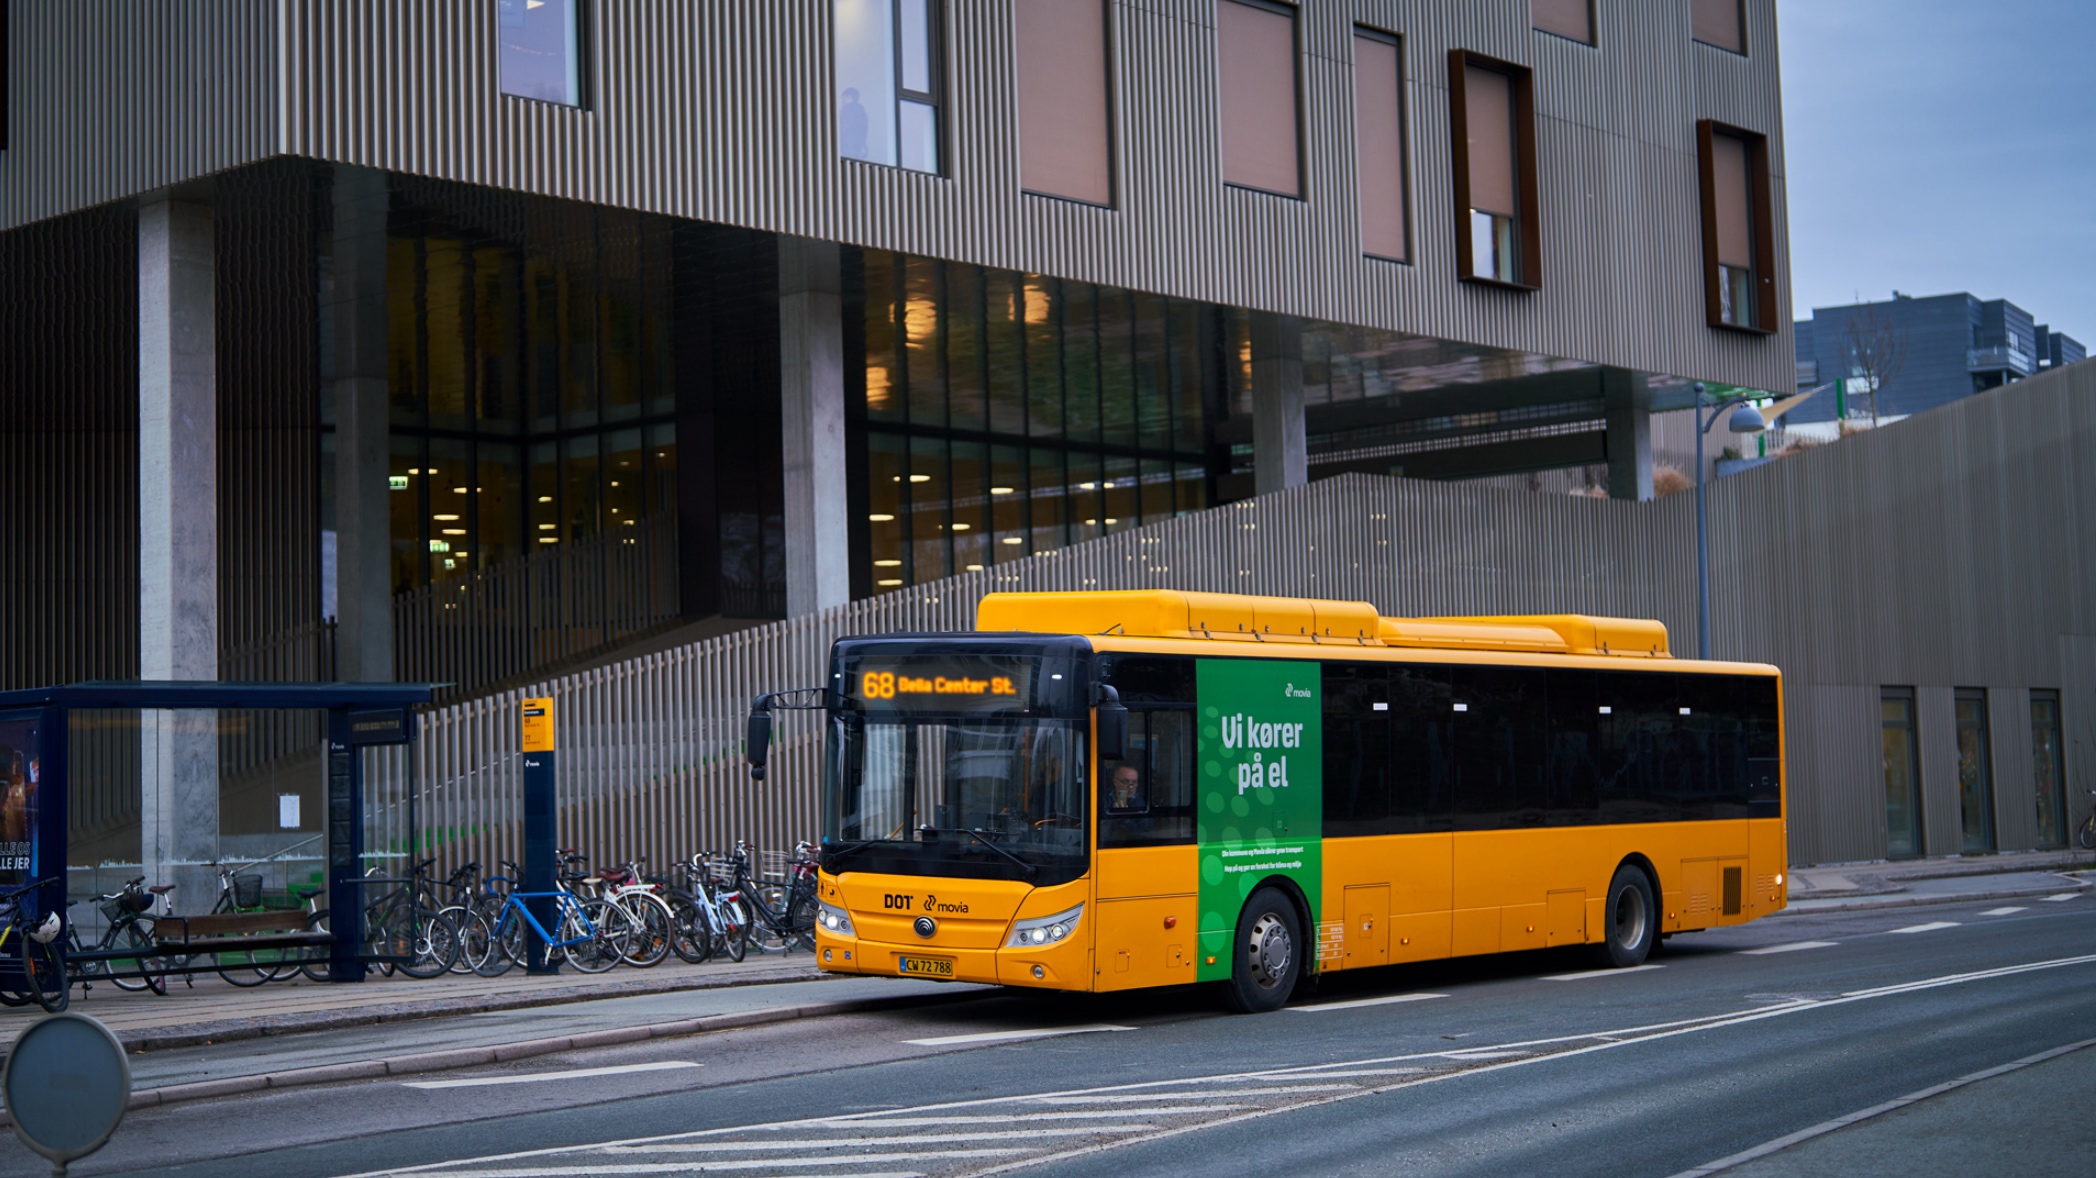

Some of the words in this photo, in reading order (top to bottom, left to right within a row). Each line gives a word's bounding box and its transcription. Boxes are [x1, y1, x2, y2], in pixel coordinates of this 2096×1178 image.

[863, 672, 895, 699] 68
[898, 676, 933, 693] Bella
[934, 676, 989, 694] Center
[991, 676, 1016, 695] St.
[1293, 688, 1311, 697] movia
[1222, 713, 1242, 749] Vi
[1247, 716, 1304, 749] kører
[1238, 752, 1264, 796] på
[1268, 755, 1289, 788] el
[17, 841, 31, 856] OS
[0, 857, 12, 870] LE
[13, 857, 30, 870] JER
[884, 894, 911, 910] DOT
[937, 902, 969, 913] movia
[906, 959, 919, 971] CW
[920, 961, 932, 972] 72
[934, 961, 951, 973] 788
